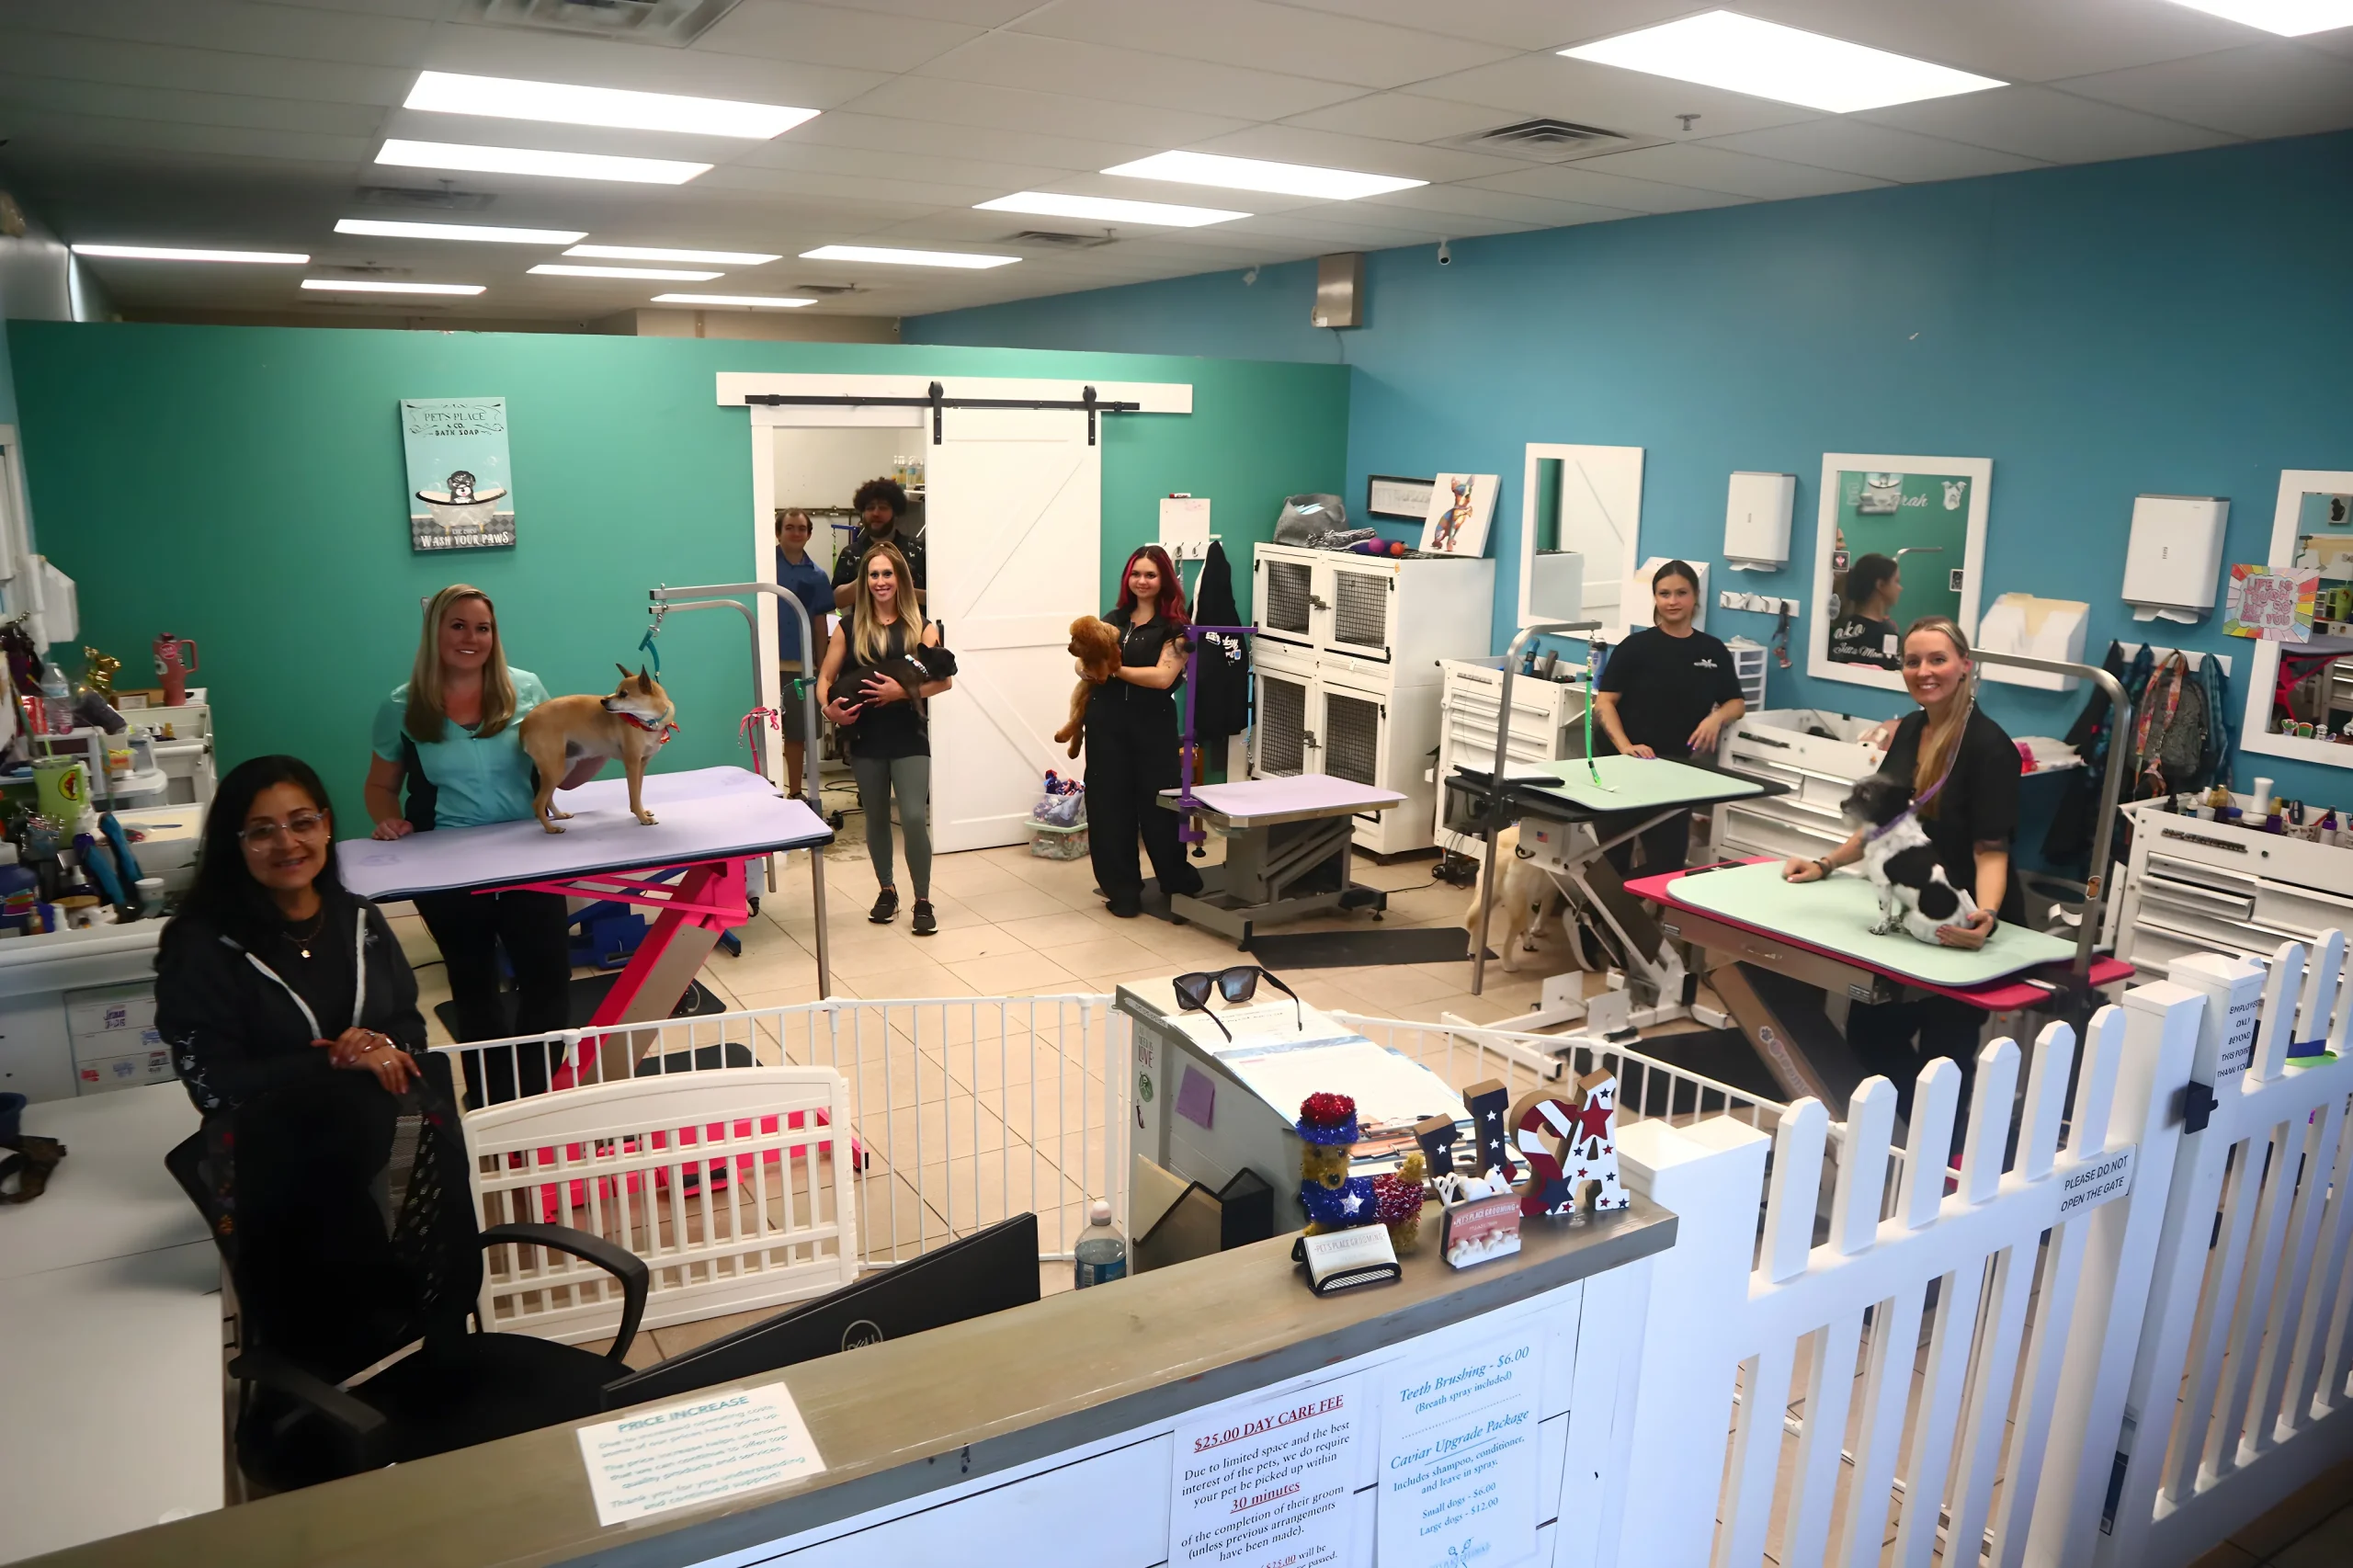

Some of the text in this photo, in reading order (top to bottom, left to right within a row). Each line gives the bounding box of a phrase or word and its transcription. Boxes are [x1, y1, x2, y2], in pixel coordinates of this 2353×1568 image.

[454, 412, 486, 421] PLACE
[454, 534, 479, 545] YOUR
[482, 531, 509, 544] PAWS
[2244, 588, 2290, 604] TOUGH
[2247, 577, 2293, 591] LIFE IS
[2266, 614, 2290, 625] YOU
[2273, 601, 2291, 614] SO
[2064, 1154, 2129, 1190] PLEASE DO NOT
[1485, 1203, 1516, 1216] GROOMING
[2061, 1176, 2125, 1211] OPEN THE GATE
[1333, 1239, 1349, 1250] PLACE
[1350, 1233, 1383, 1246] GROOMING
[1400, 1381, 1431, 1403] Teeth
[1434, 1365, 1486, 1391] Brushing
[1496, 1346, 1529, 1368] $6.00
[1415, 1370, 1512, 1415] (Breath spray included)
[618, 1396, 750, 1432] PRICE INCREASE
[1195, 1394, 1343, 1451] $25.00 DAY CARE FEE
[1185, 1422, 1349, 1481] Due to limited space and the best
[1391, 1410, 1529, 1470] Caviar Upgrade Package
[1182, 1436, 1349, 1495] interest of the pets, we do require
[1194, 1452, 1337, 1508] your pet be picked up within
[1393, 1436, 1525, 1492] Includes shampoo, conditioner,
[1421, 1459, 1498, 1494] and leave in spray.
[1232, 1482, 1300, 1511] 30 minutes
[1422, 1502, 1445, 1518] Small
[1447, 1496, 1465, 1508] dogs
[1181, 1486, 1344, 1547] of the completion of their groom
[1188, 1502, 1336, 1560] (unless previous arrangements
[1419, 1522, 1441, 1536] Large
[1444, 1514, 1463, 1526] dogs
[1471, 1496, 1498, 1515] $12.00
[1220, 1525, 1304, 1562] have been made).
[1298, 1547, 1314, 1559] will
[1316, 1544, 1326, 1553] be
